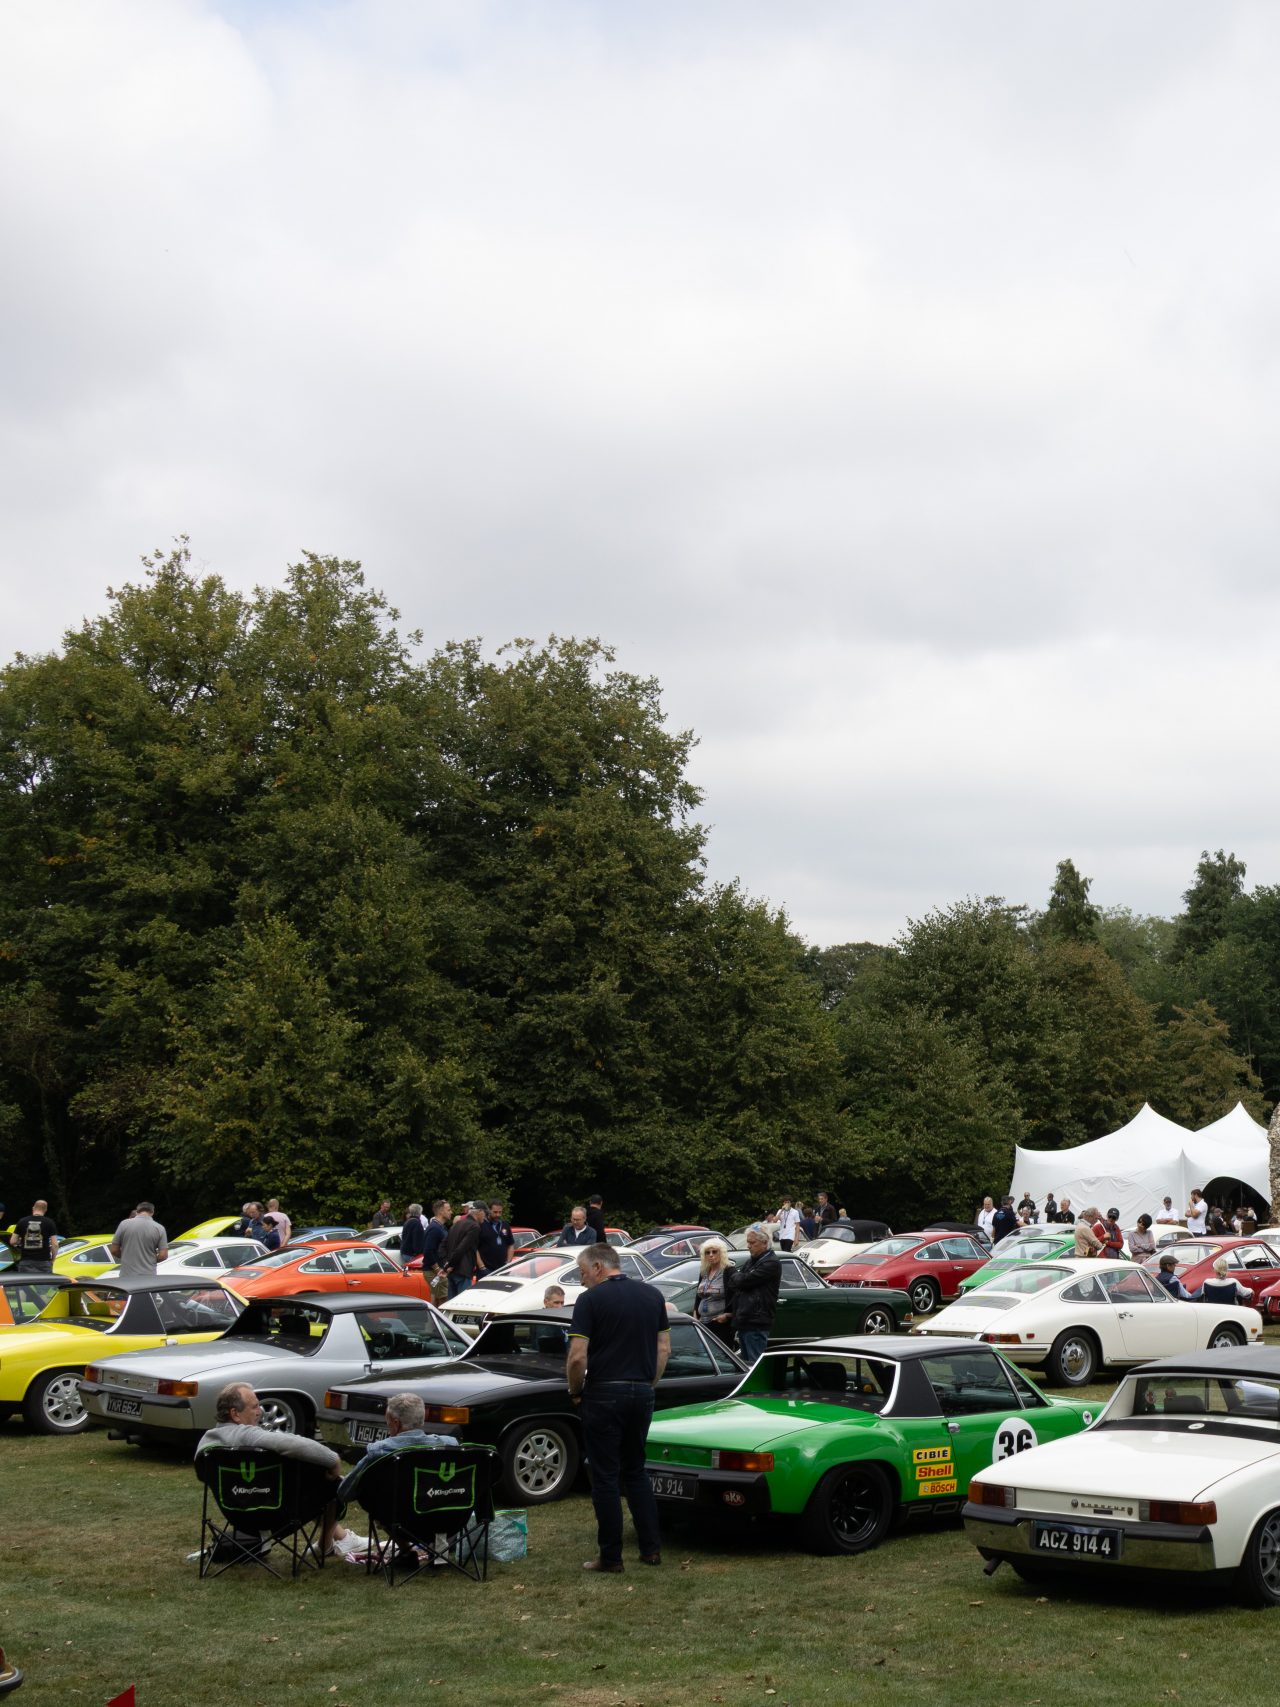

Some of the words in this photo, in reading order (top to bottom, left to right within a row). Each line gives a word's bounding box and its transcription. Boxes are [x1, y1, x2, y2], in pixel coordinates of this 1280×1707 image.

[358, 1426, 375, 1441] HGU
[999, 1429, 1032, 1461] 36
[918, 1465, 951, 1477] Shell
[434, 1487, 465, 1496] KingCamp
[649, 1477, 663, 1492] YS
[667, 1480, 684, 1496] 914
[930, 1483, 955, 1493] BOSCH
[1040, 1530, 1068, 1550] ACZ
[1073, 1533, 1098, 1553] 914
[1101, 1537, 1111, 1554] 4
